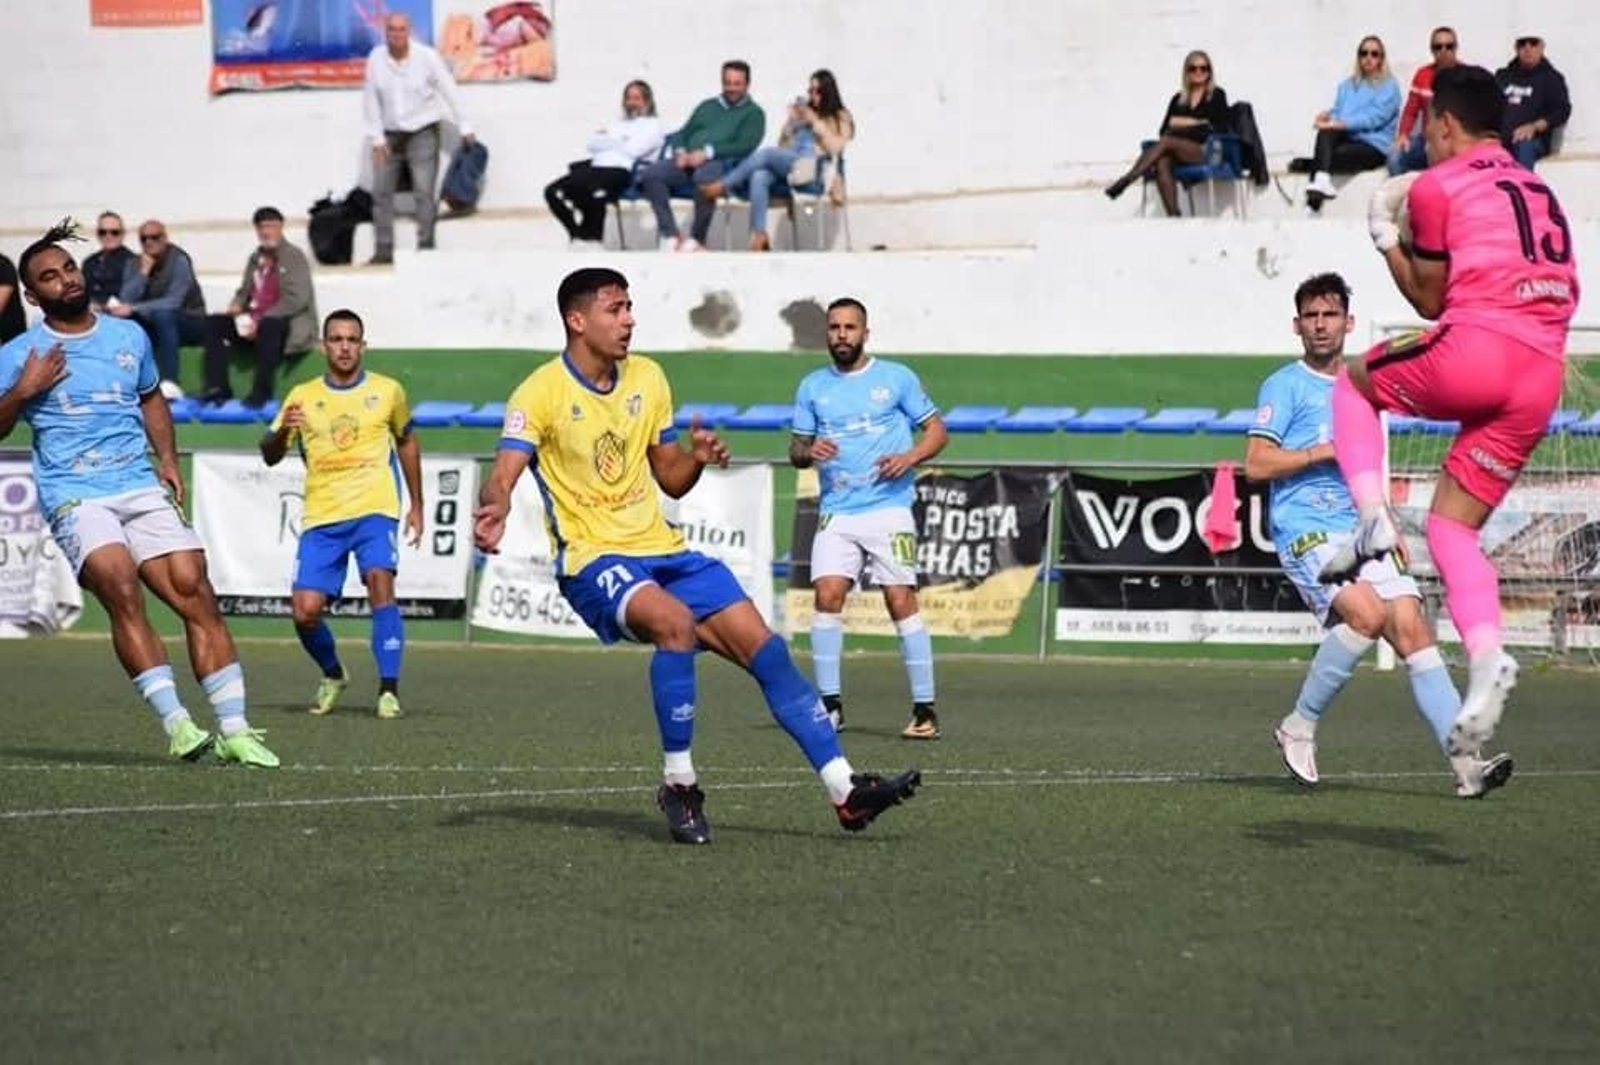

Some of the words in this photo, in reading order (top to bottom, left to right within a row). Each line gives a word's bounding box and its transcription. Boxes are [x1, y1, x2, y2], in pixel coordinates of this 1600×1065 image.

[1494, 180, 1572, 264] 13
[923, 504, 1020, 540] POSTA
[596, 564, 633, 599] 21
[488, 585, 531, 621] 956
